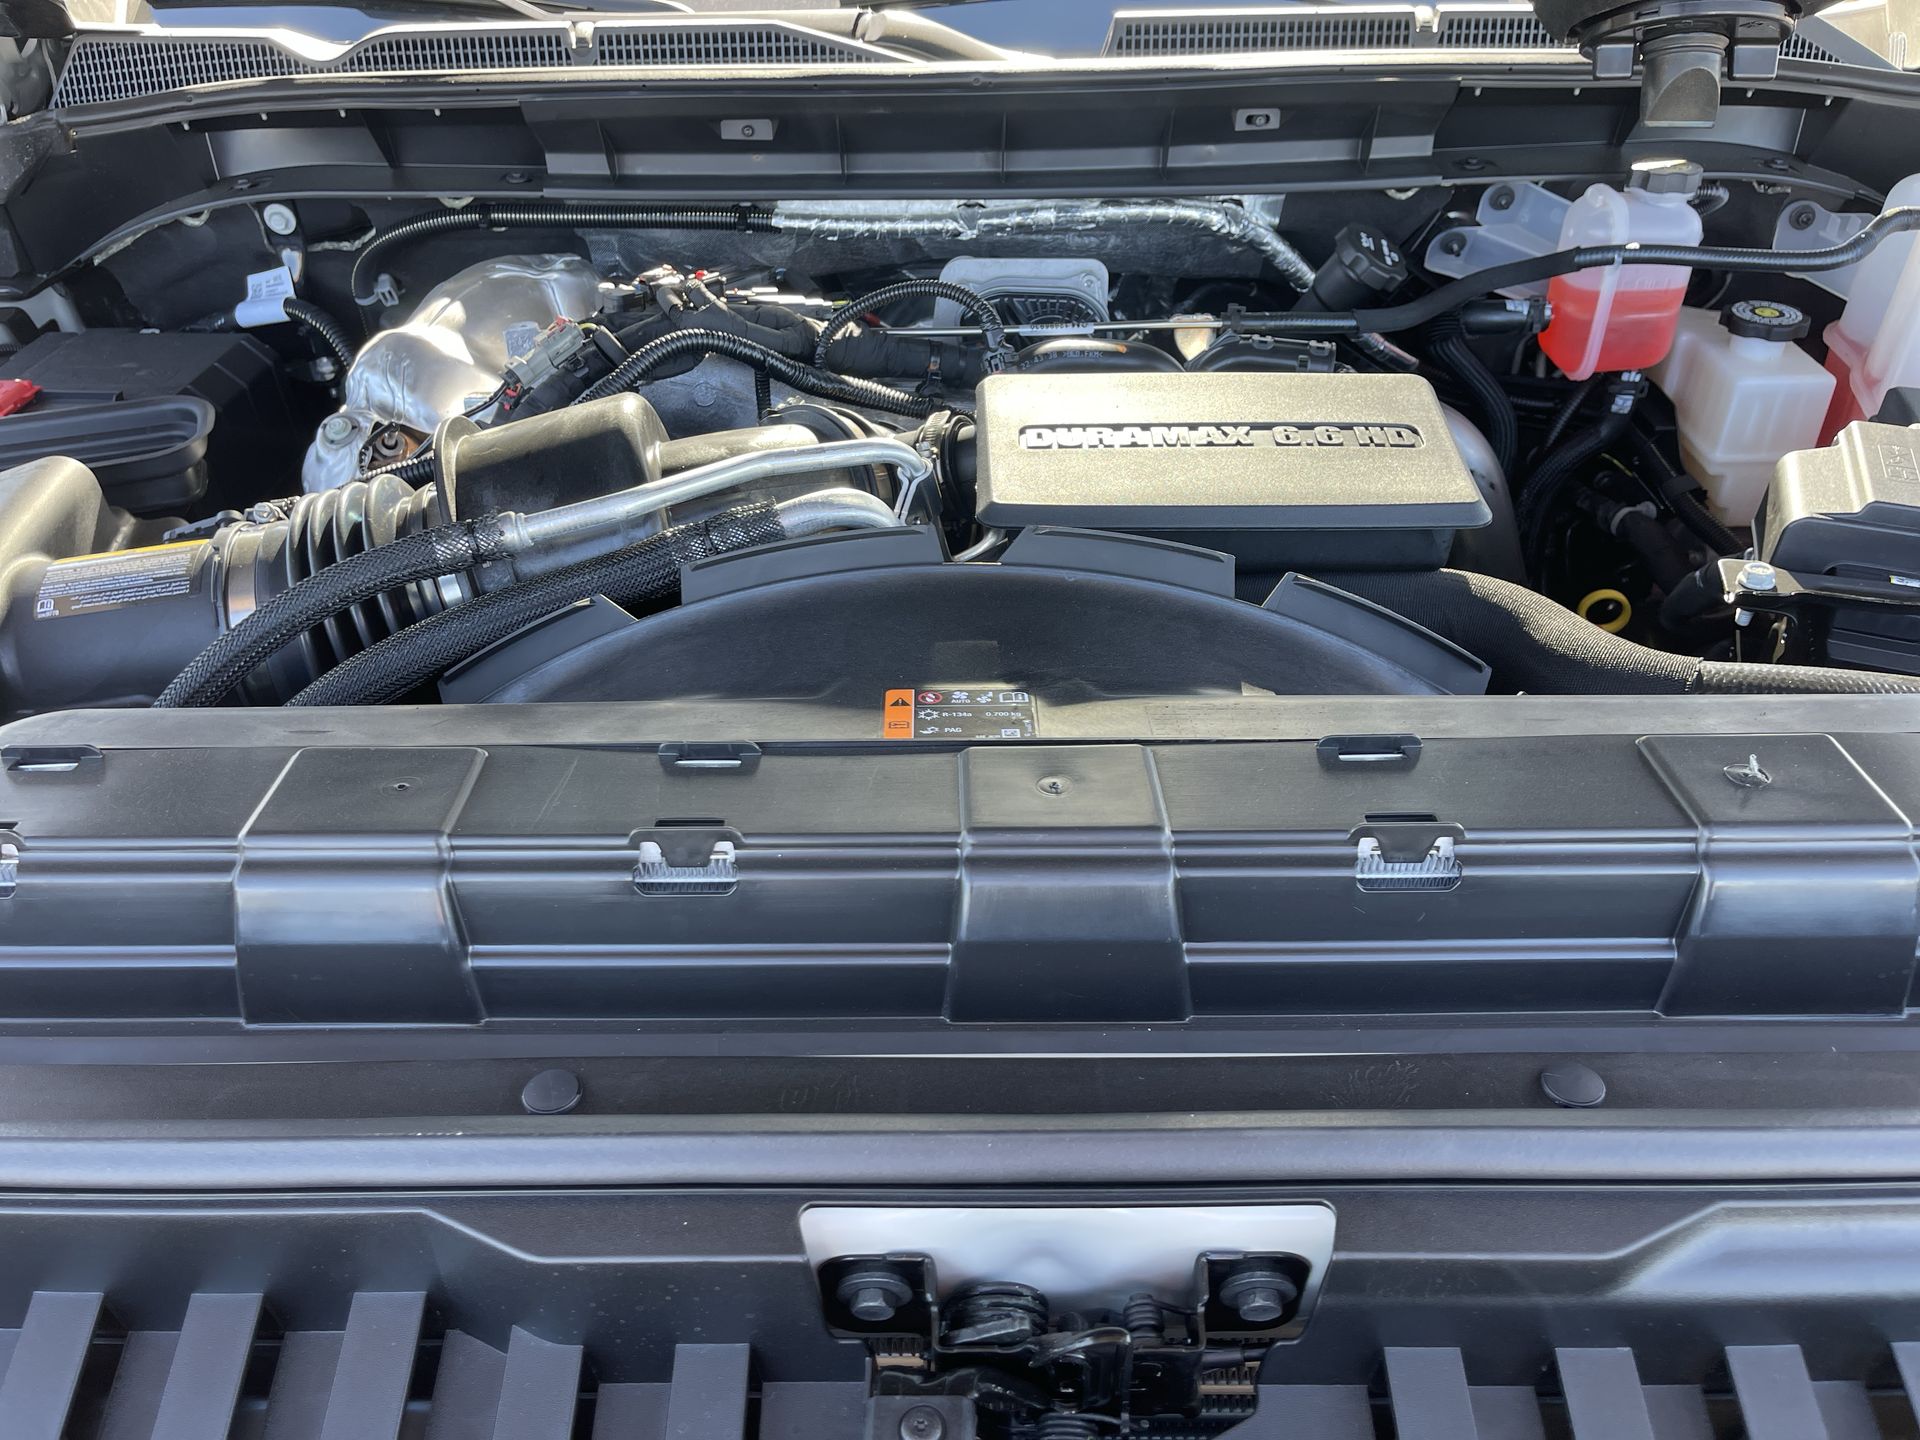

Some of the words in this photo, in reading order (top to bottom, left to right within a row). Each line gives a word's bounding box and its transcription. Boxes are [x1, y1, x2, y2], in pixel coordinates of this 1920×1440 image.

[1023, 426, 1254, 448] DURAMAX
[1273, 425, 1344, 447] 6.6
[1353, 426, 1419, 447] HD
